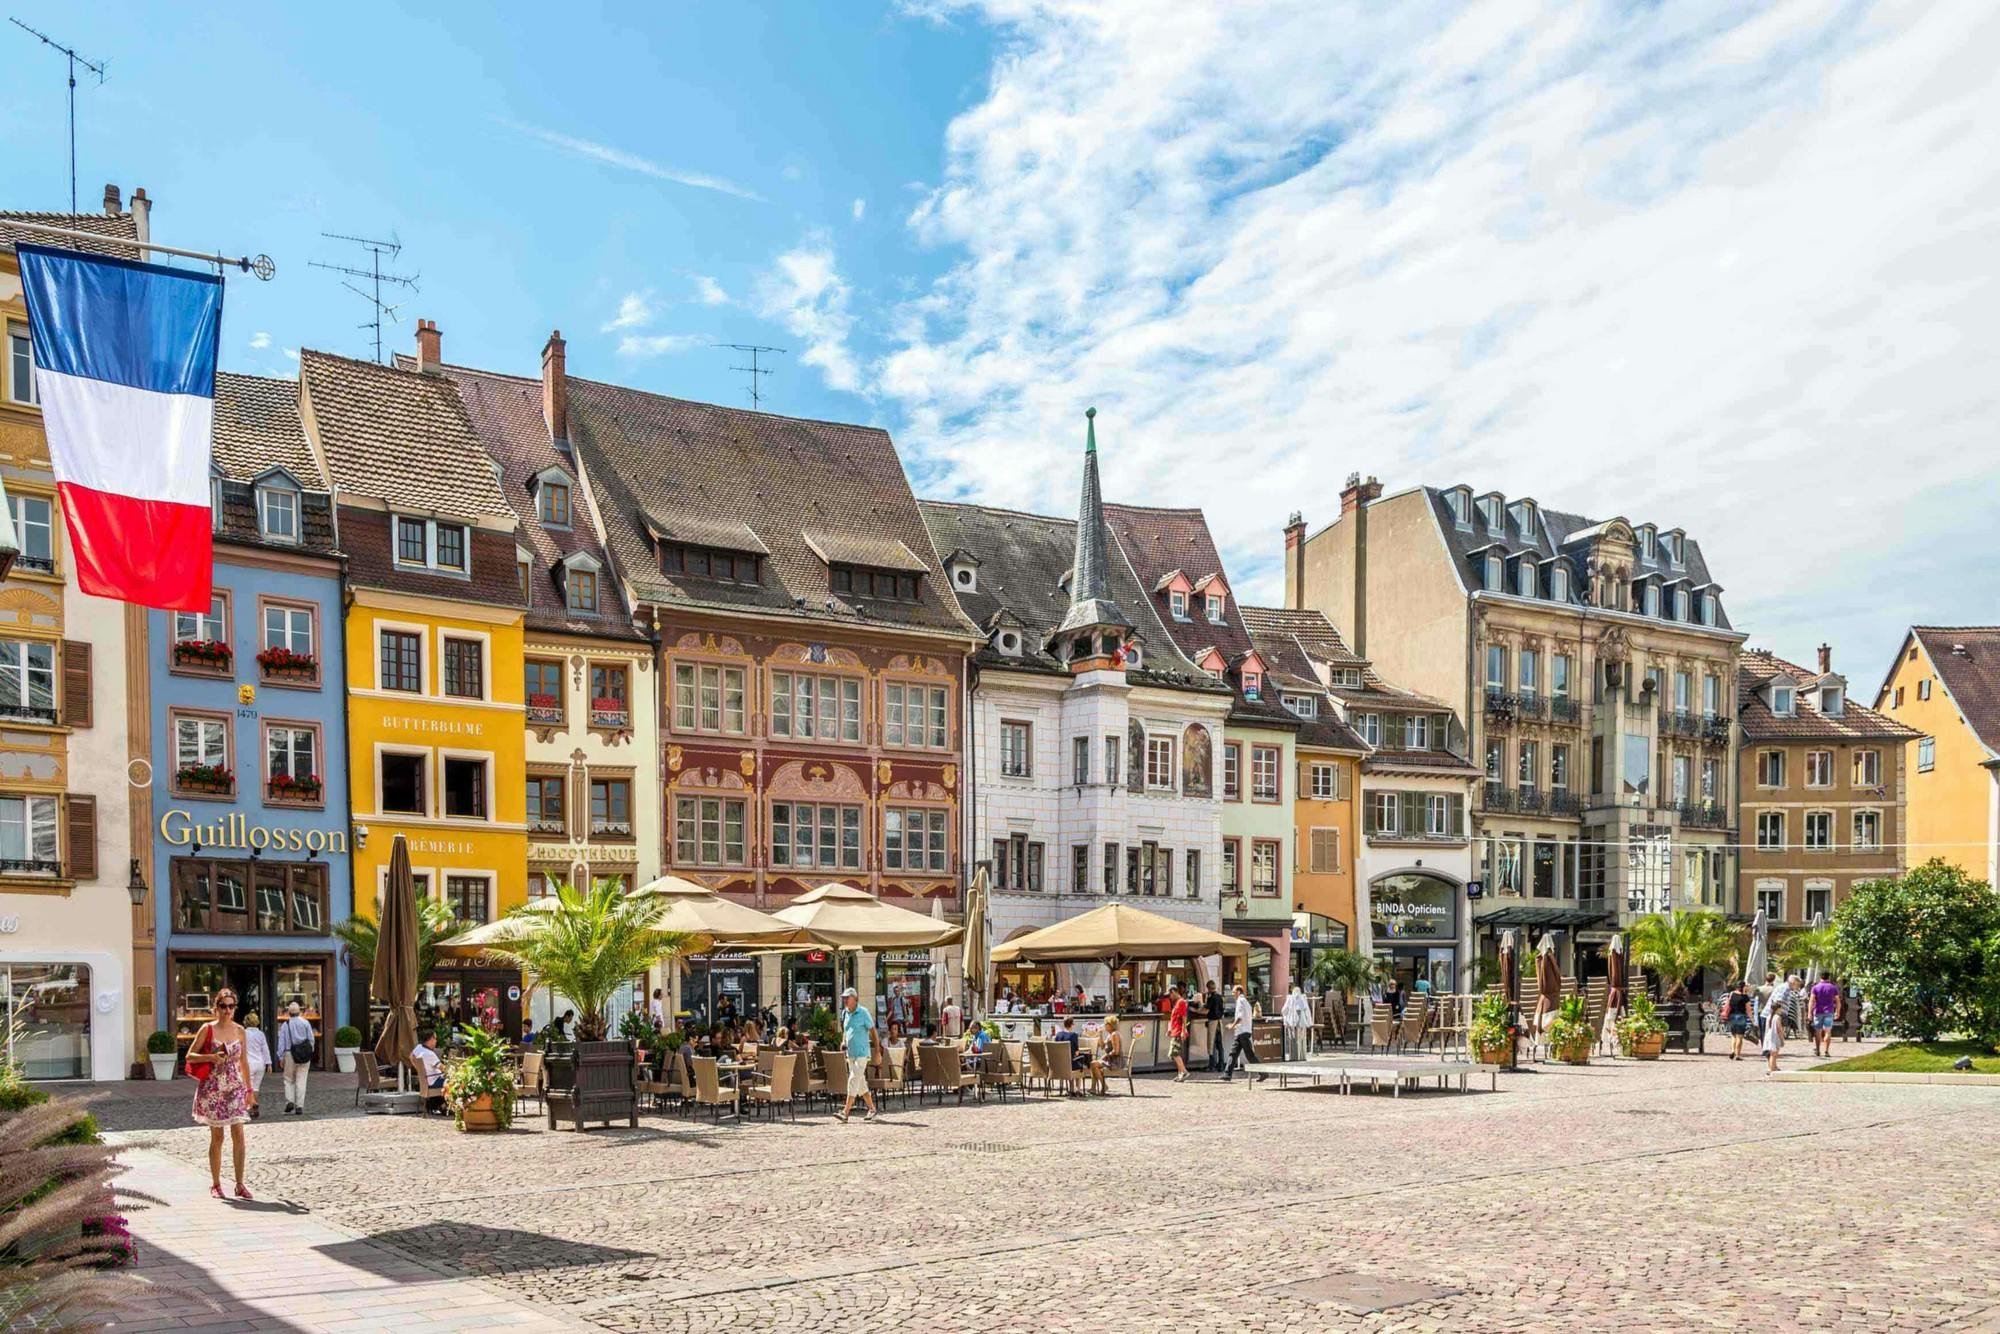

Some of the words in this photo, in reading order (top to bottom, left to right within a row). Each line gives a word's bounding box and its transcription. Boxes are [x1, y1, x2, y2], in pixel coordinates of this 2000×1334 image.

[237, 708, 258, 719] 1479
[383, 716, 483, 735] BUTTERBLUME
[160, 809, 348, 853] Guillosson
[410, 837, 474, 854] RÉMERIE
[1376, 903, 1406, 914] BINDA
[1407, 903, 1446, 916] Opticiens
